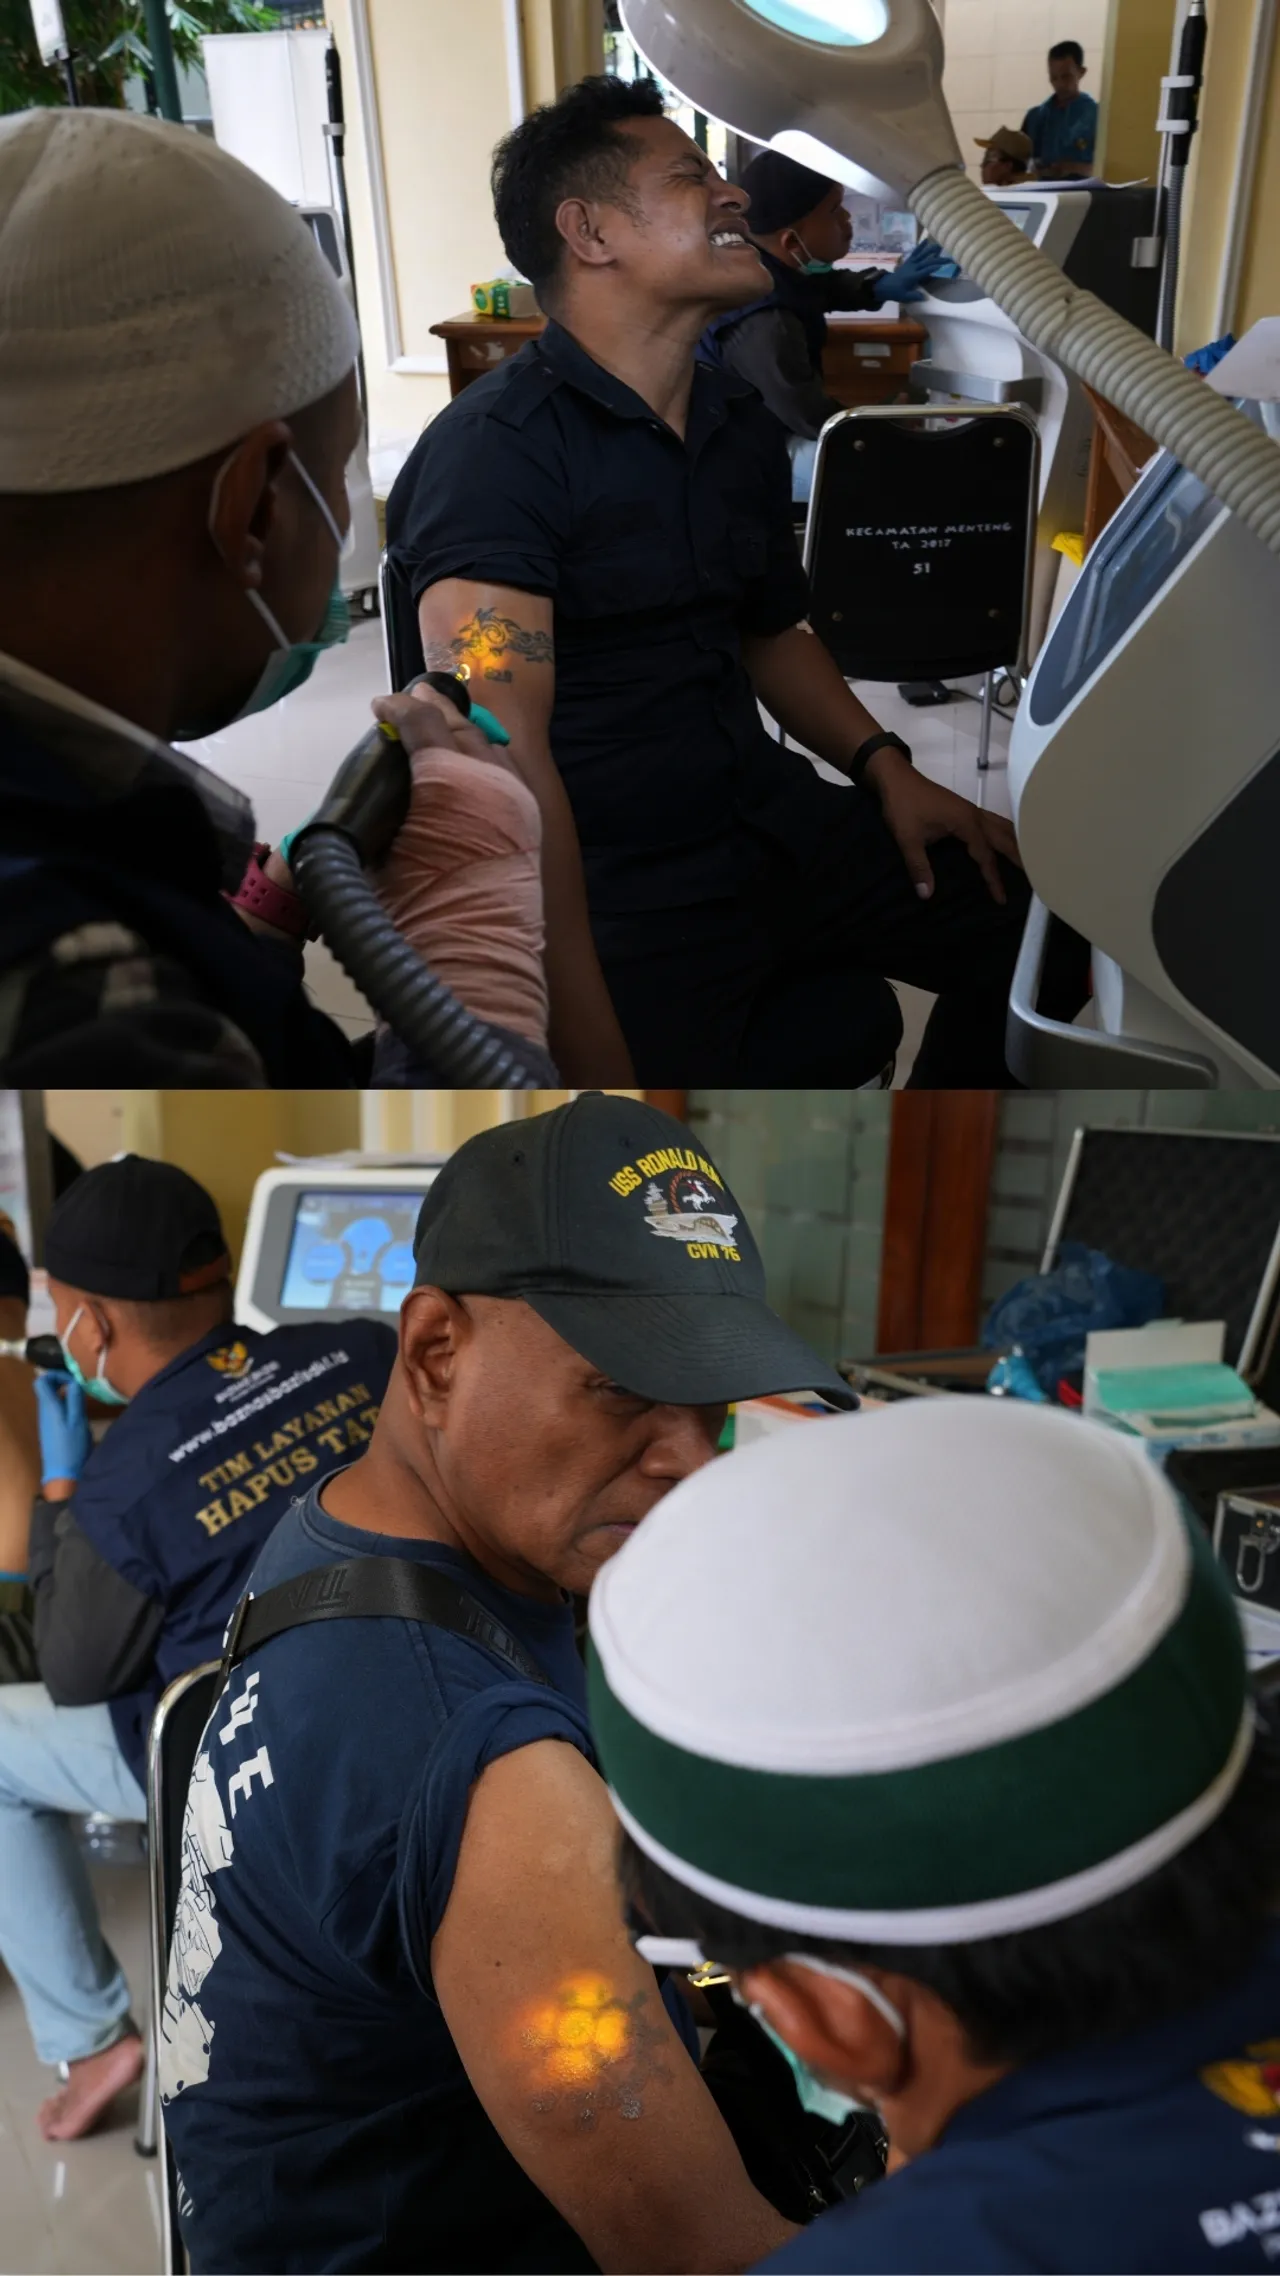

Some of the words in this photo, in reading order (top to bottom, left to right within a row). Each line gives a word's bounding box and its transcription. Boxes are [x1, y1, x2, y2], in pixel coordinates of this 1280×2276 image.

[846, 526, 938, 537] KECAMATAN
[945, 522, 1012, 534] MENTENG
[891, 540, 910, 550] TA
[921, 539, 951, 549] 2017
[913, 562, 931, 574] 51
[608, 1165, 643, 1198] USS
[636, 1147, 699, 1178] RONALD
[686, 1243, 720, 1260] CVN
[720, 1246, 742, 1262] 76
[199, 1451, 254, 1493] TIM
[253, 1383, 373, 1462] LAYANAN
[195, 1446, 319, 1537] HAPUS
[317, 1405, 382, 1455] TAT
